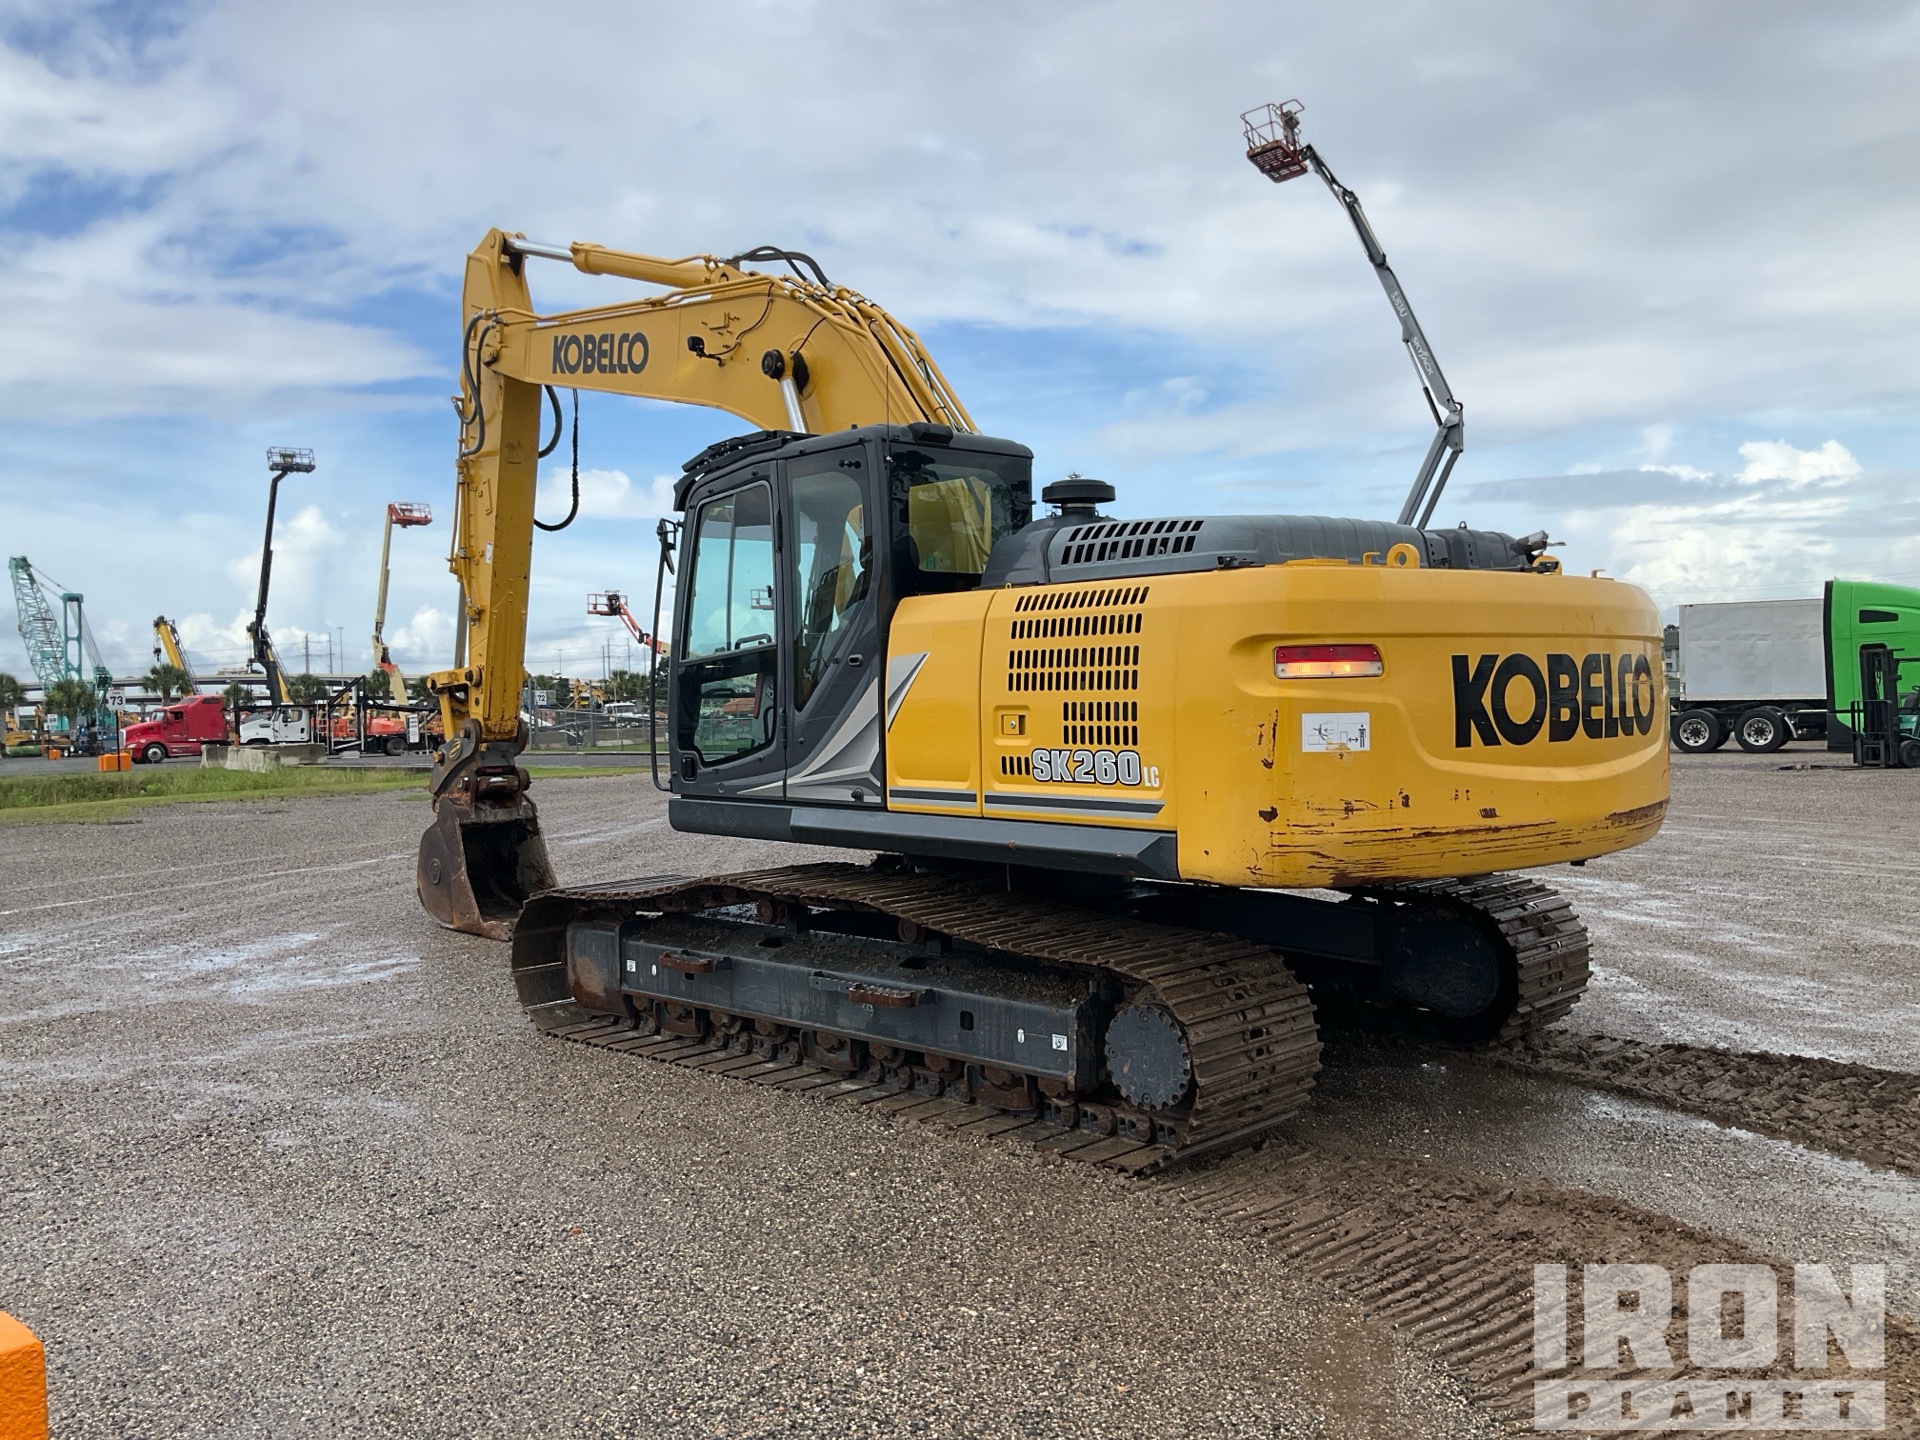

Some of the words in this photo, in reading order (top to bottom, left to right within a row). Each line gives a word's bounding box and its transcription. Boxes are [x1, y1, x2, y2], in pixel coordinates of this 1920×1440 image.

[1391, 291, 1407, 317] SJ63AJ
[552, 332, 649, 374] KOBELCO
[1411, 336, 1434, 376] SKYJACK
[110, 696, 123, 706] 73
[1451, 653, 1654, 748] KOBELCO
[1031, 747, 1142, 786] SK260
[1143, 766, 1160, 788] LC
